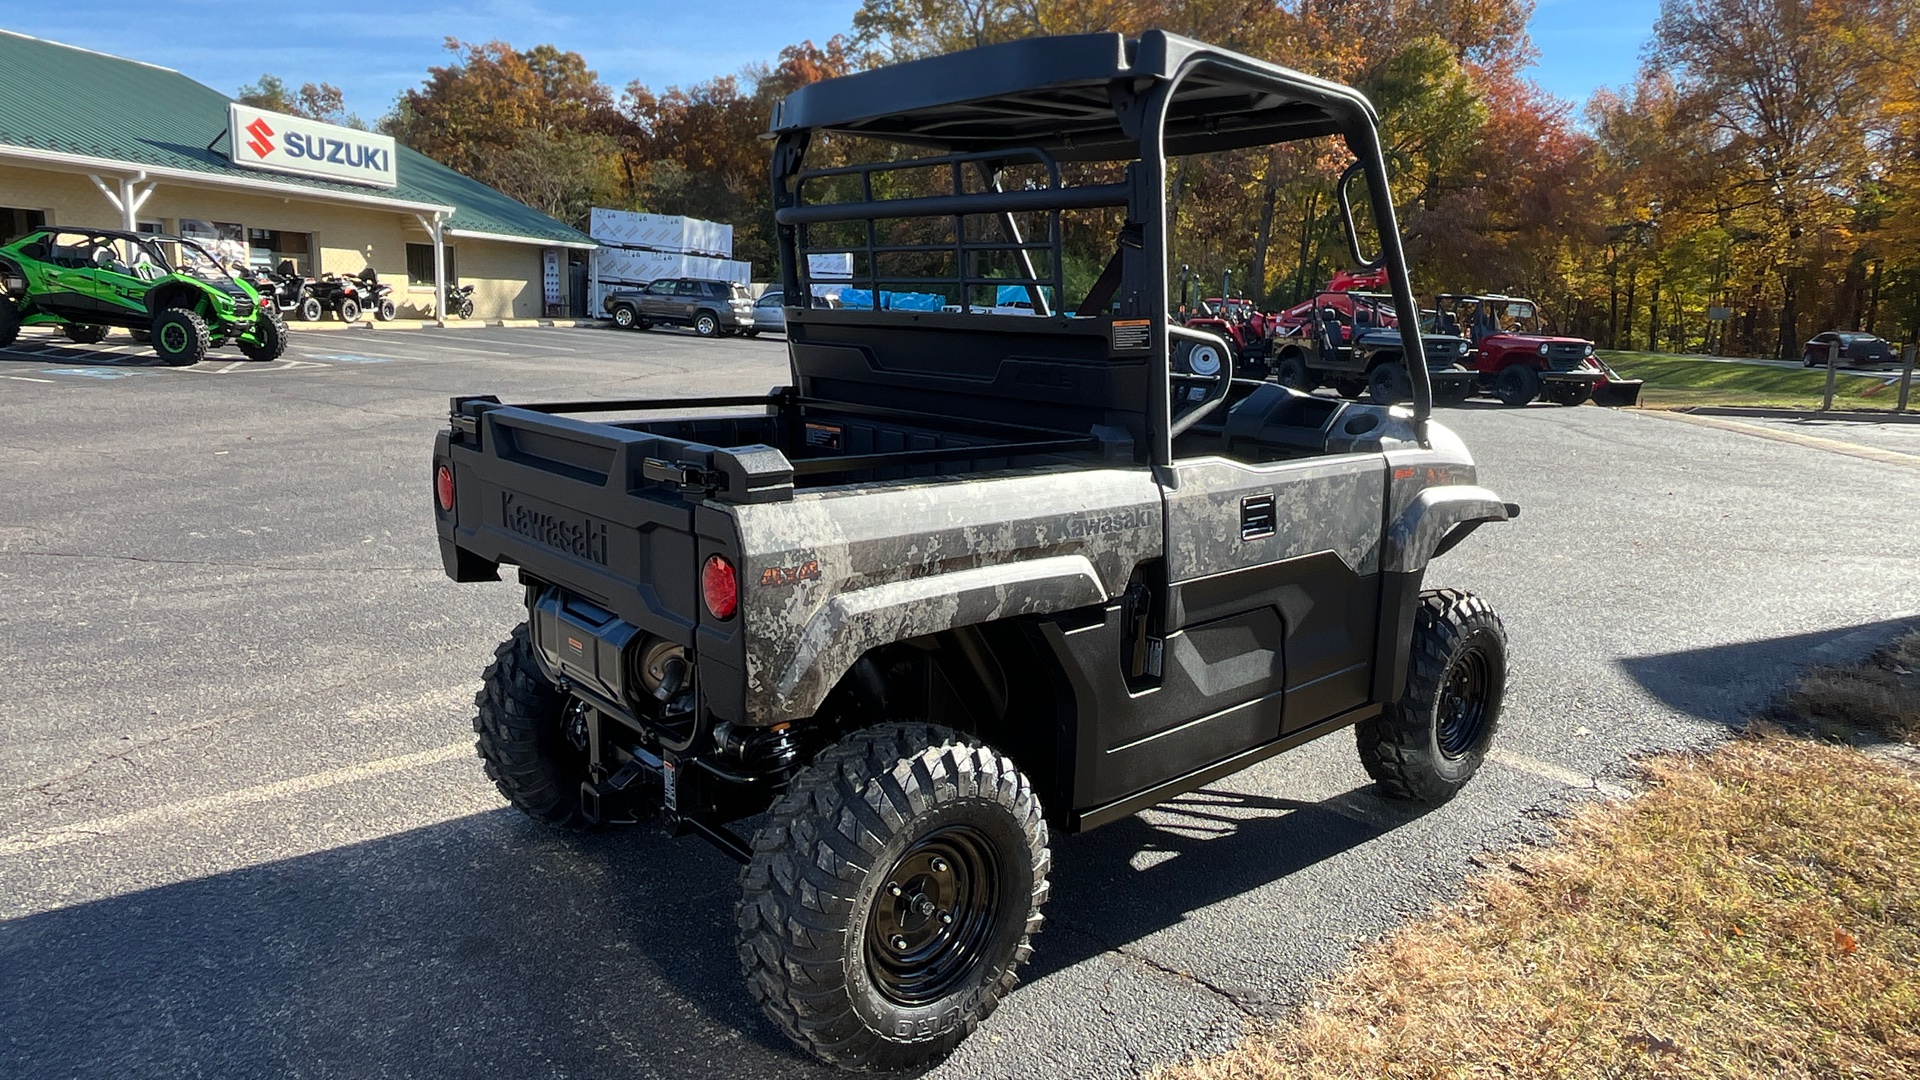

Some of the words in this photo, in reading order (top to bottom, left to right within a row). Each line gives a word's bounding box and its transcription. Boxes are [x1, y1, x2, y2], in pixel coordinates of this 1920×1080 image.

[283, 130, 389, 172] SUZUKI
[501, 490, 608, 567] Kawasaki
[1055, 508, 1153, 539] Kawasaki
